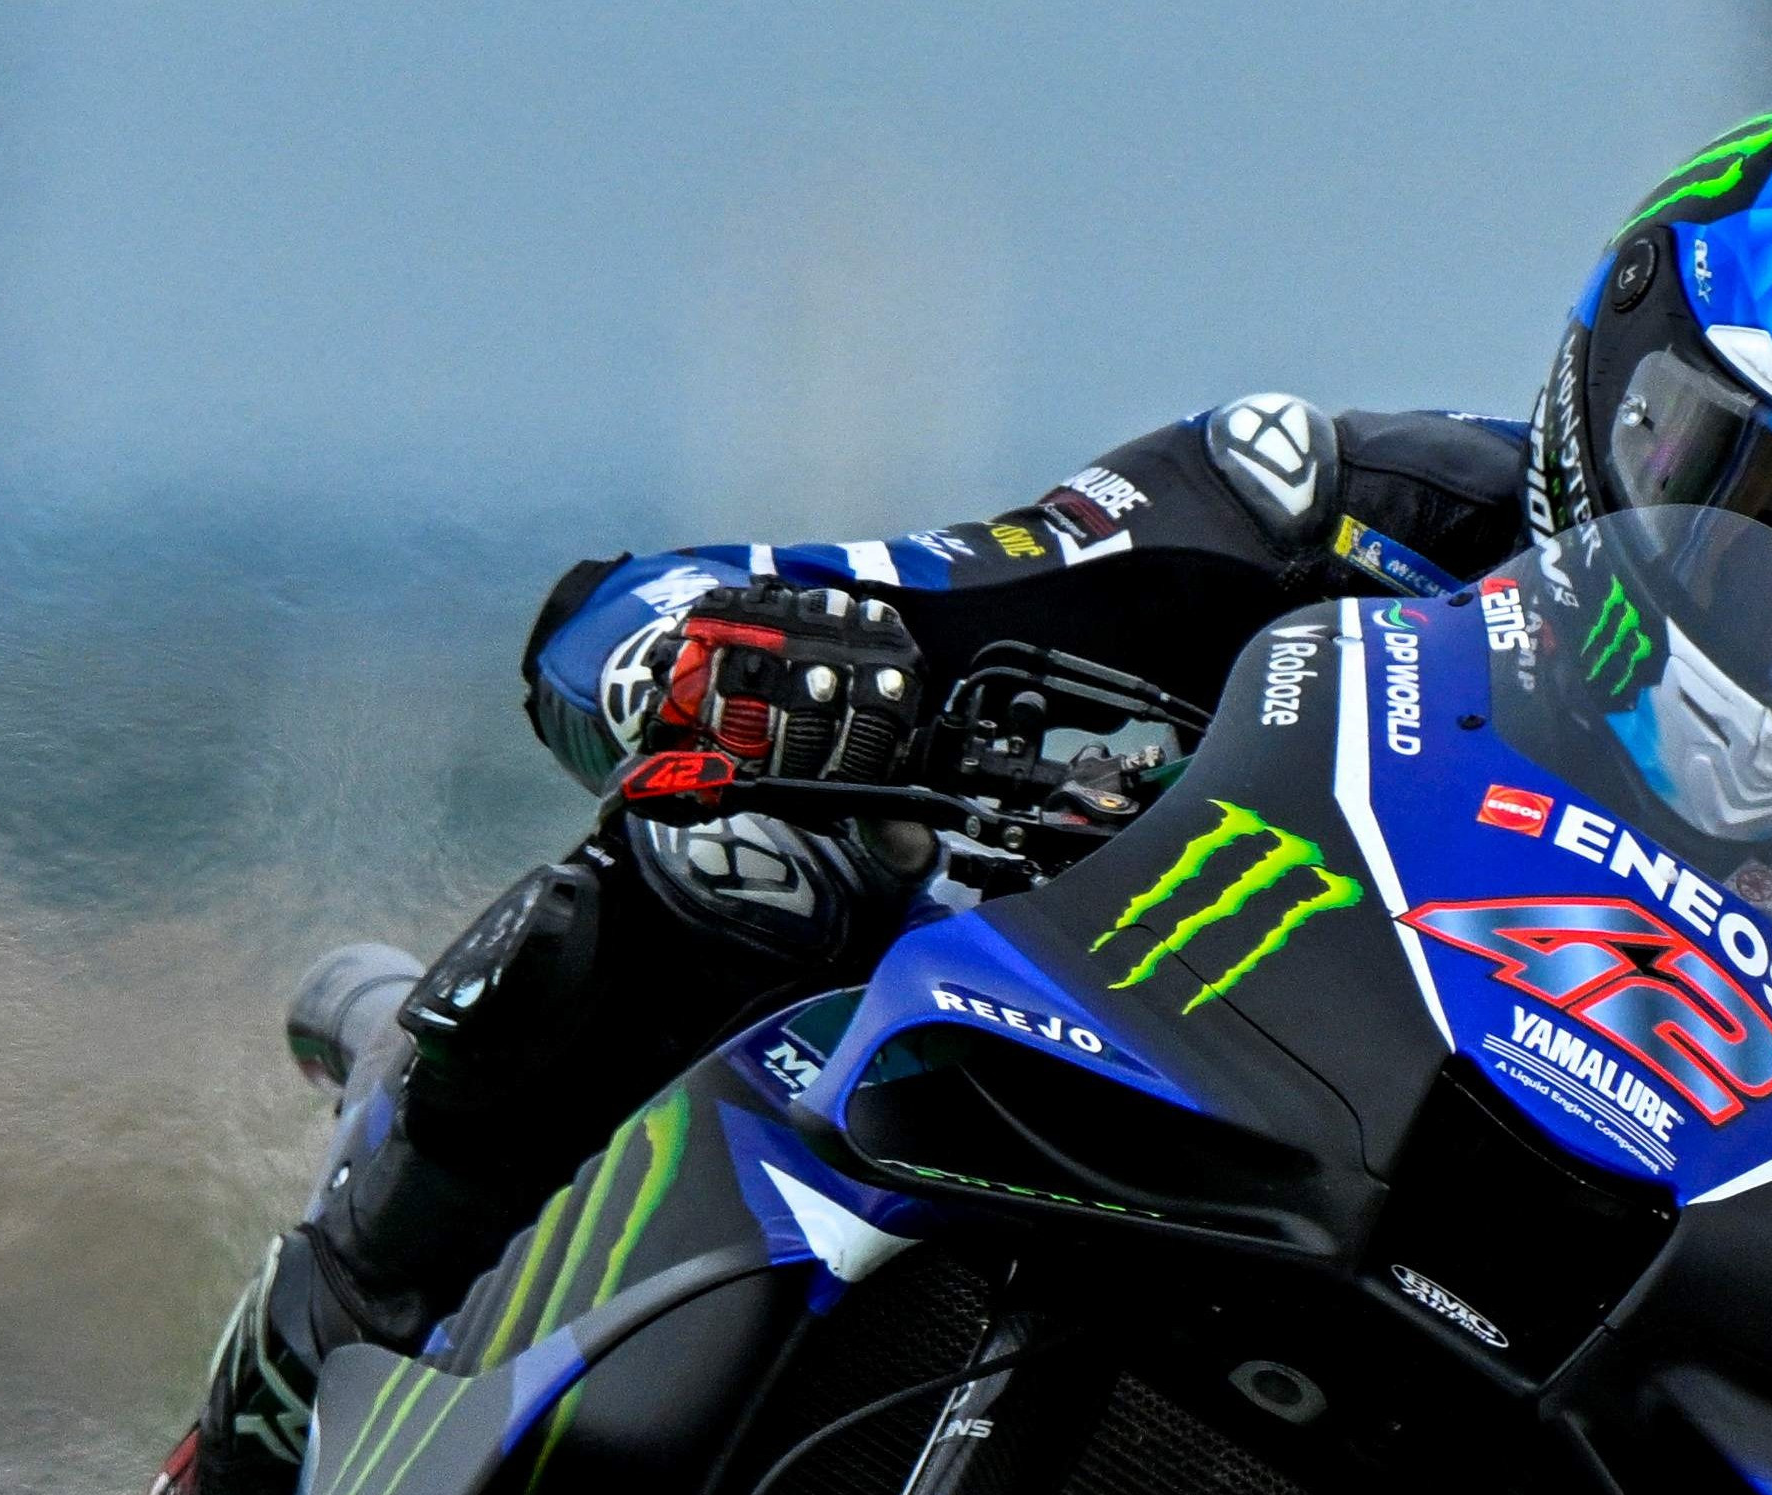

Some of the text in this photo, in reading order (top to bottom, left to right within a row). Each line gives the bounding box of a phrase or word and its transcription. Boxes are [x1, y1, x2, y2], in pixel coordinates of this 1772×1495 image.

[1261, 642, 1319, 726] Roboze
[1384, 632, 1421, 756] DP WORLD
[1487, 799, 1542, 820] ENEOS
[1495, 1061, 1661, 1176] A Liquid Engine Component
[1511, 1005, 1679, 1143] YAMALUBE
